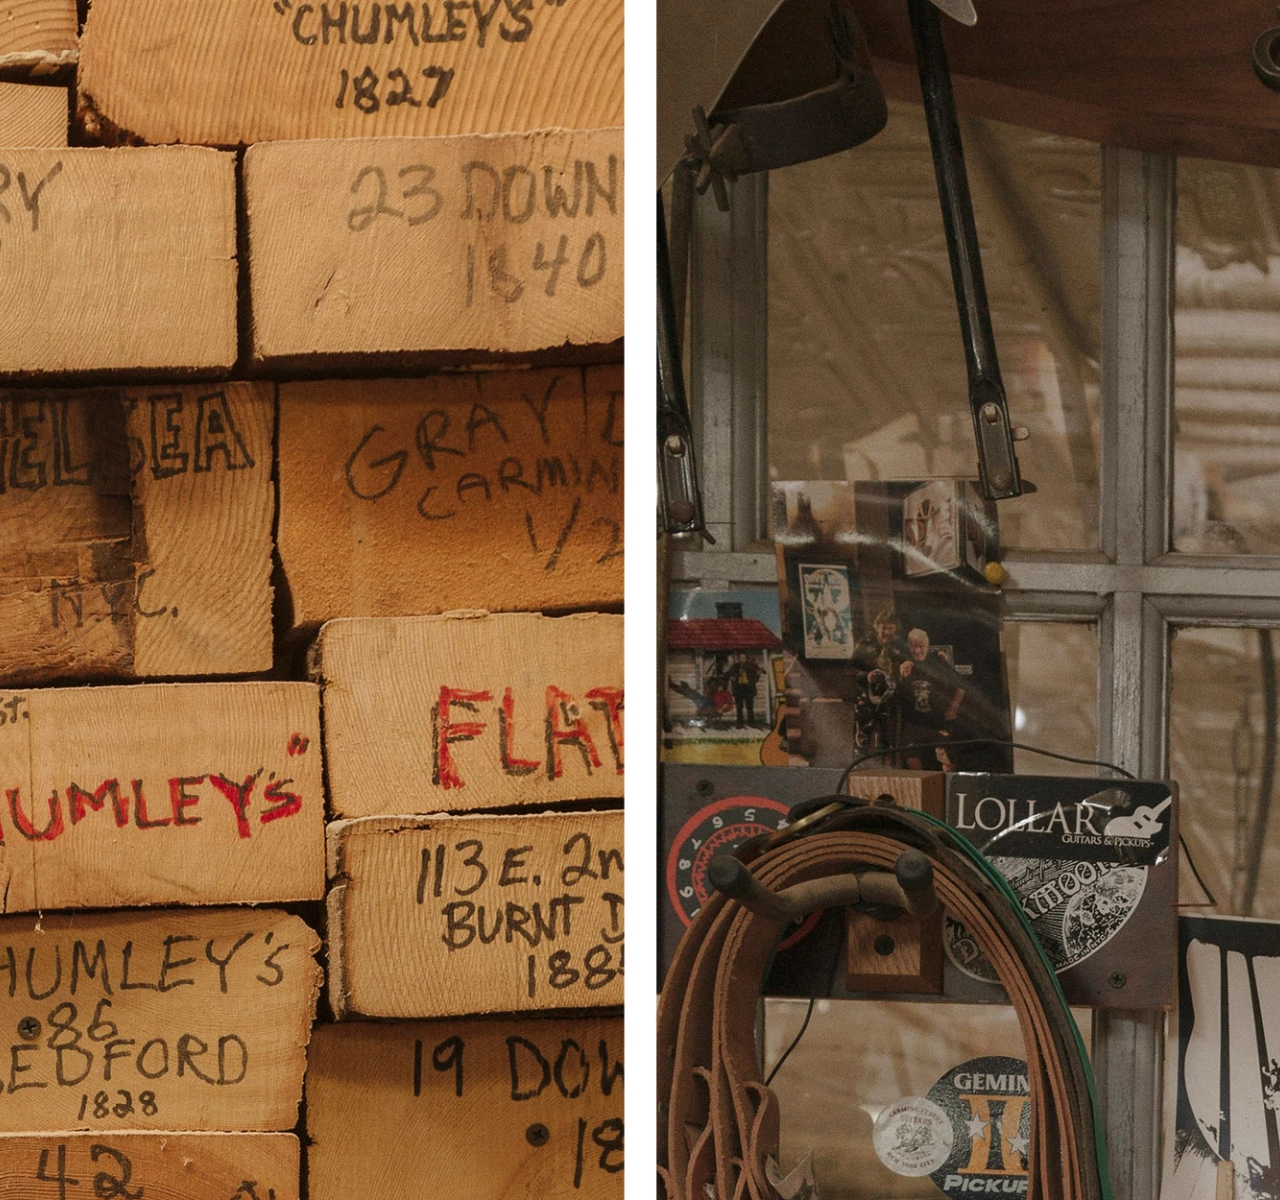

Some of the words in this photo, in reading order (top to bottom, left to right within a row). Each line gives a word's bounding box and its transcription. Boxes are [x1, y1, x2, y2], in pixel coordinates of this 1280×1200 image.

[335, 65, 455, 114] 1827
[347, 164, 444, 233] 23
[465, 231, 608, 309] 1840
[956, 792, 1103, 836] LOLLAR
[1060, 834, 1102, 846] GUITARS
[420, 839, 489, 905] 113
[441, 894, 584, 952] BURNT
[47, 998, 119, 1051] 86
[412, 1038, 466, 1097] 19
[77, 1089, 160, 1121] 1828
